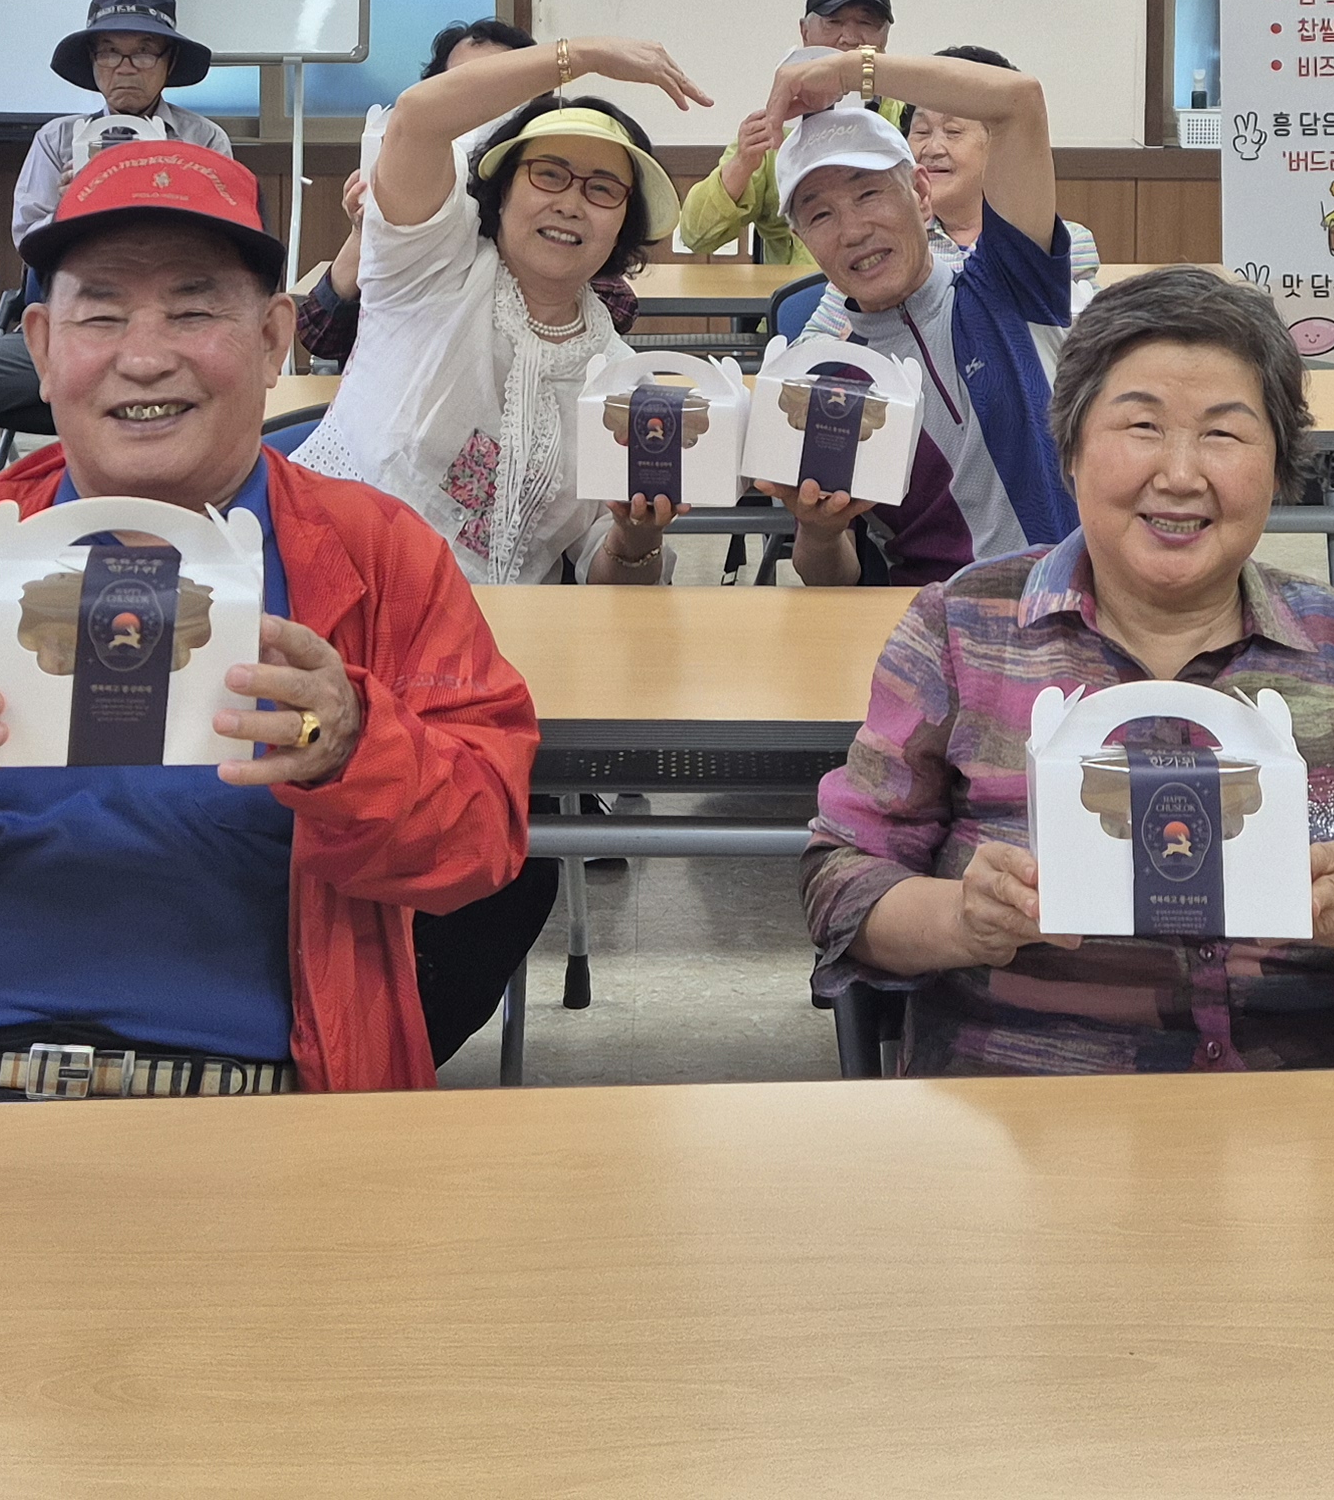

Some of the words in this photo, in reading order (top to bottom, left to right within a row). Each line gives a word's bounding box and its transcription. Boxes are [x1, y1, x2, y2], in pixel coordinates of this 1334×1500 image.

[1273, 112, 1292, 136] 흥
[1283, 275, 1303, 298] 맛
[1149, 755, 1196, 769] 한가위
